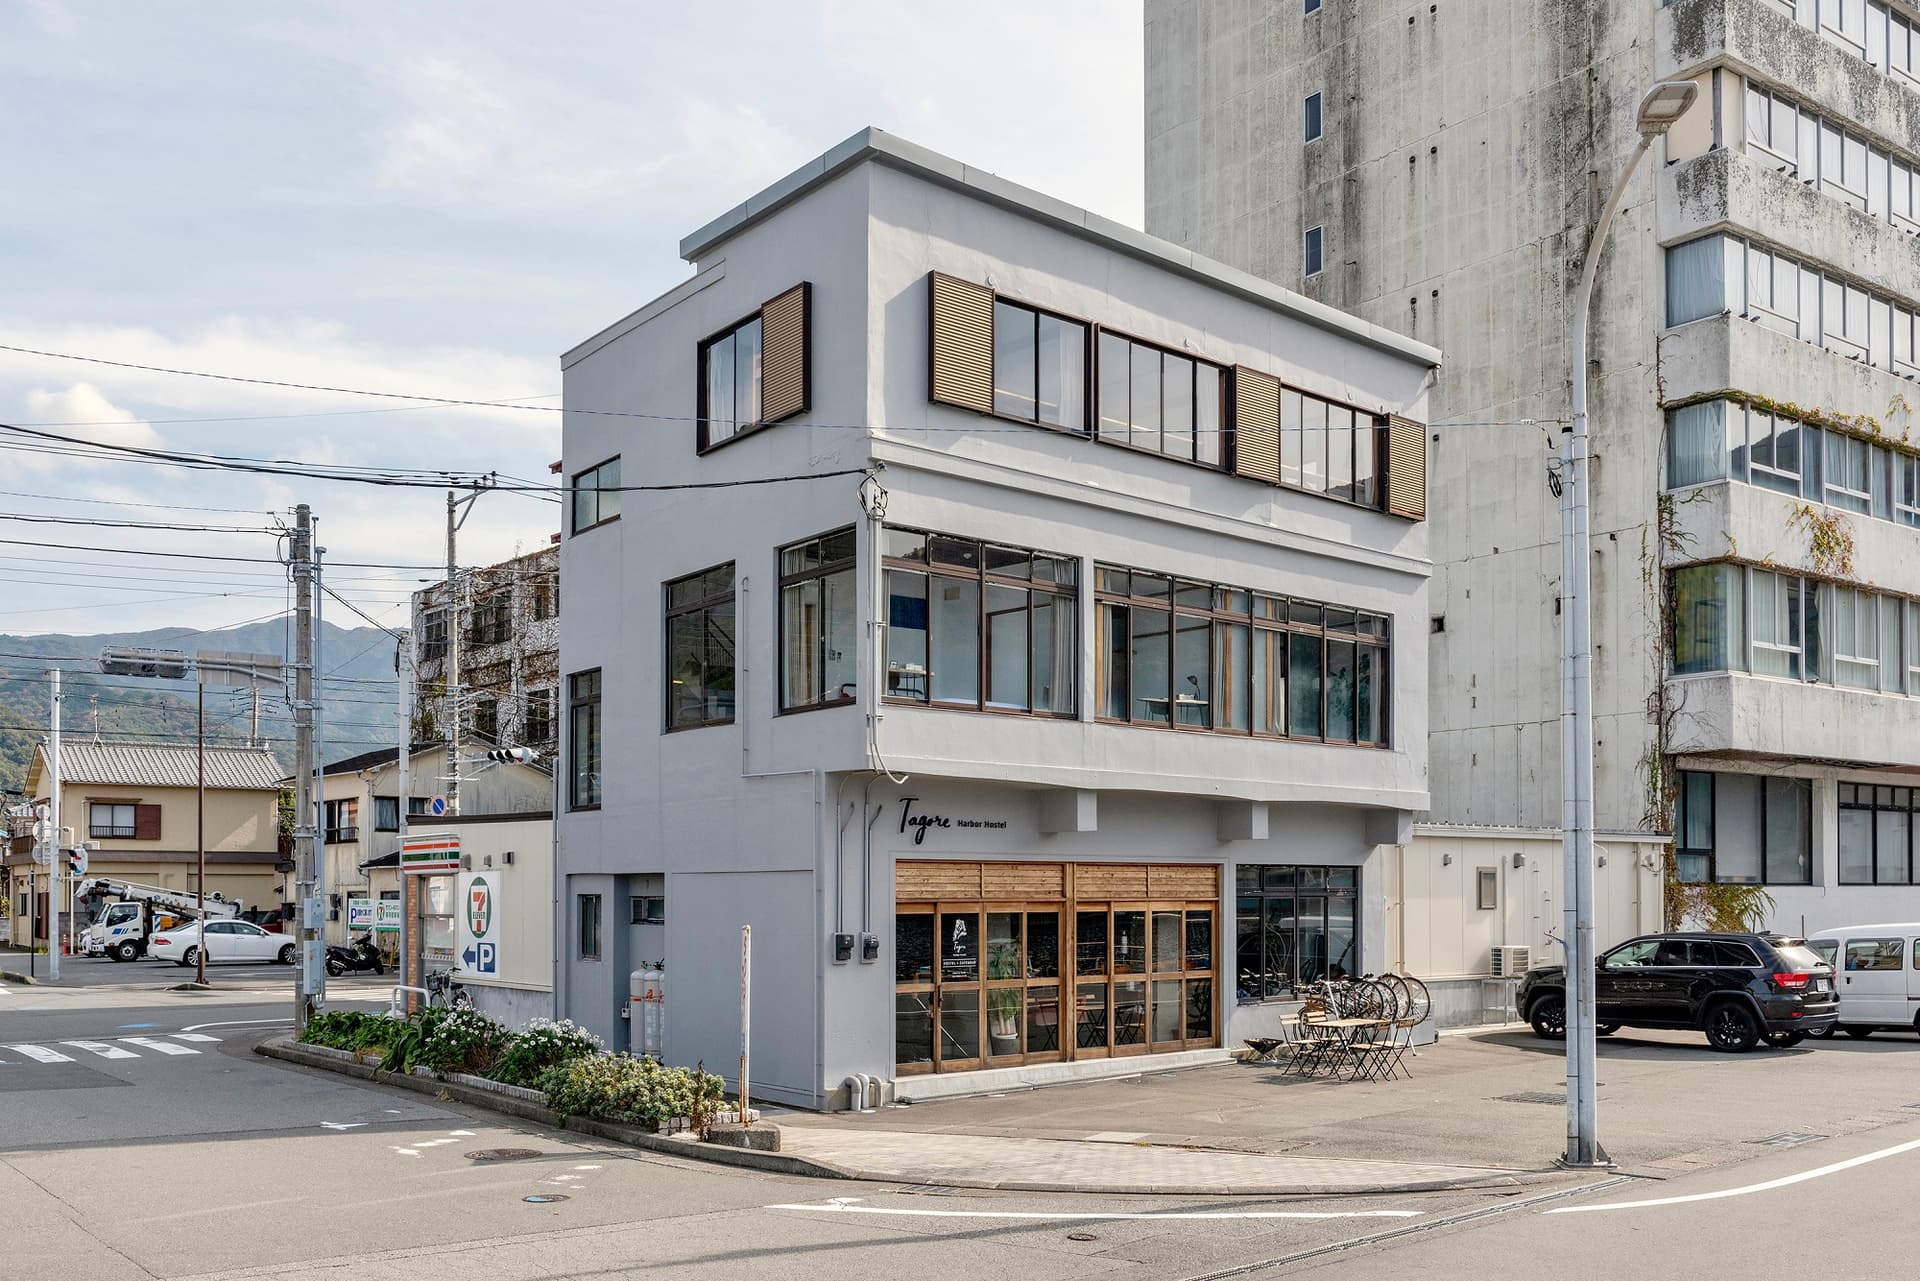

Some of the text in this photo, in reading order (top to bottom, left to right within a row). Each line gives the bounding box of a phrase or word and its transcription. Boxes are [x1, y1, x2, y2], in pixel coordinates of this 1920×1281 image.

[899, 797, 1007, 845] Tagore Harbor Hostel
[479, 943, 494, 971] P
